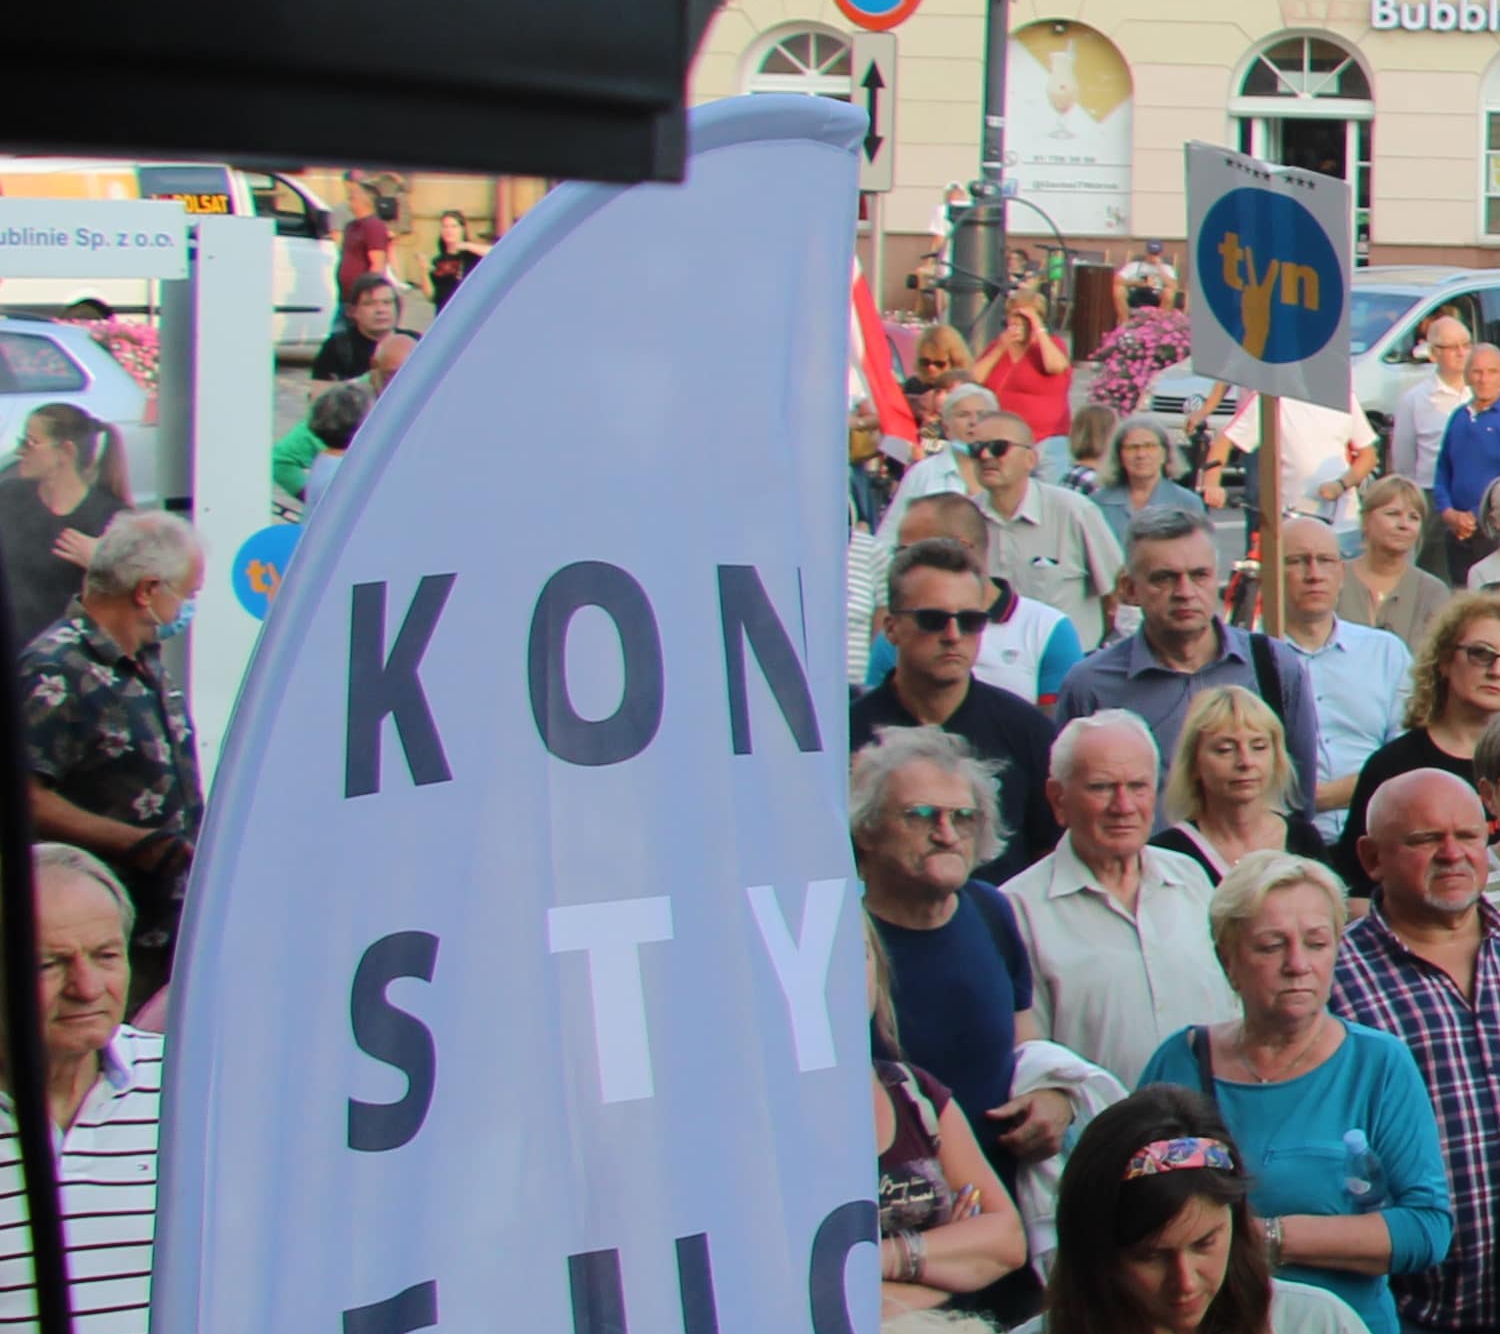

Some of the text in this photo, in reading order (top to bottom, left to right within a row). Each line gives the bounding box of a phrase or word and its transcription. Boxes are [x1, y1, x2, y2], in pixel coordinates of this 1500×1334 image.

[76, 228, 111, 251] Sp.
[117, 233, 129, 247] z
[135, 233, 175, 248] o.o.
